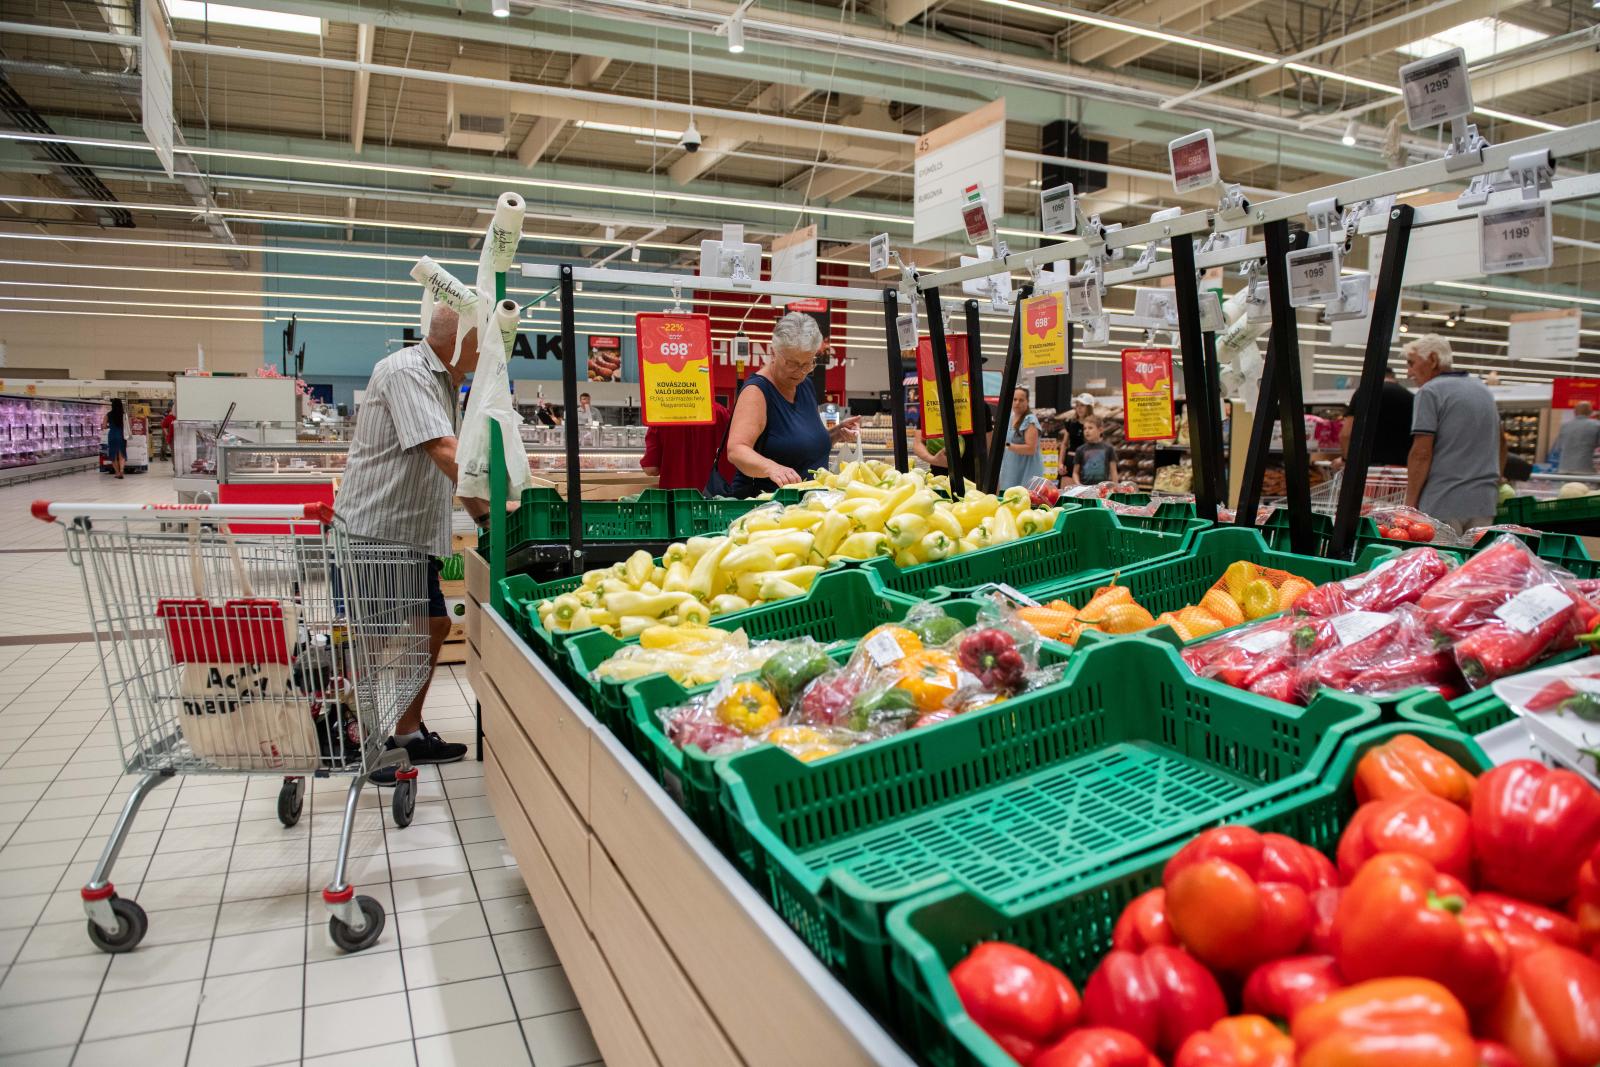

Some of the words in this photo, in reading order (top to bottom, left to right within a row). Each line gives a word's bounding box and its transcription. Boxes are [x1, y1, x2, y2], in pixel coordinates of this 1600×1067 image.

[1424, 79, 1449, 94] 1299
[1502, 226, 1530, 240] 1199
[1304, 267, 1324, 279] 1099
[428, 272, 464, 301] Auchan
[660, 323, 686, 332] -22%
[660, 342, 689, 356] 698
